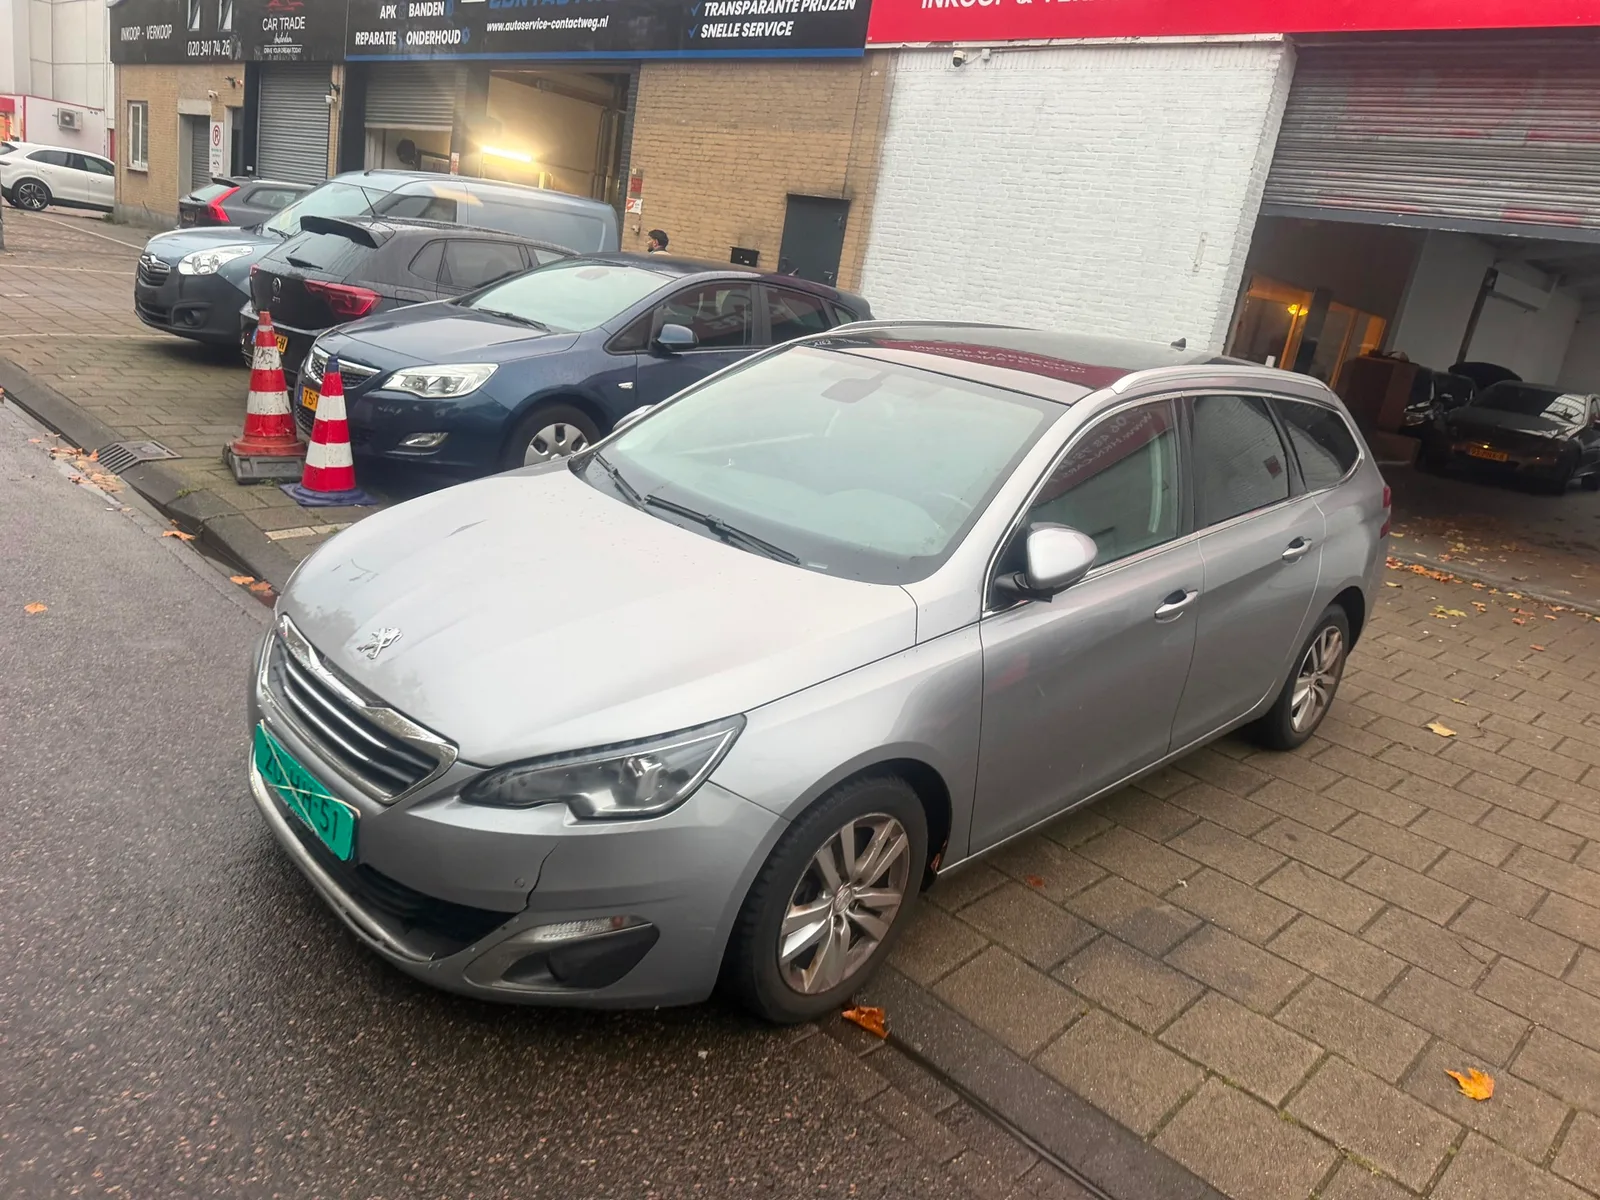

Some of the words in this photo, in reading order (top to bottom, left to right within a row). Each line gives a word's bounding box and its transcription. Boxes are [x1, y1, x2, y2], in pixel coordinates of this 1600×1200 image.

[380, 5, 397, 19] APK
[408, 2, 445, 17] BANDEN
[704, 0, 799, 17] TRANSPARANTE
[800, 0, 857, 12] PRIJZEN
[262, 18, 278, 31] CAR
[280, 16, 306, 30] TRADE
[486, 15, 609, 32] www.autoservice-contactweg.nl
[700, 23, 741, 38] SNELLE
[741, 21, 794, 37] SERVICE
[121, 26, 140, 41] INKOOP
[146, 24, 172, 40] VERKOOP
[355, 31, 397, 45] REPARATIE
[406, 29, 461, 45] ONDERHOUD
[187, 41, 200, 56] 020
[200, 40, 212, 56] 341
[213, 40, 221, 56] 74
[222, 39, 231, 55] 26
